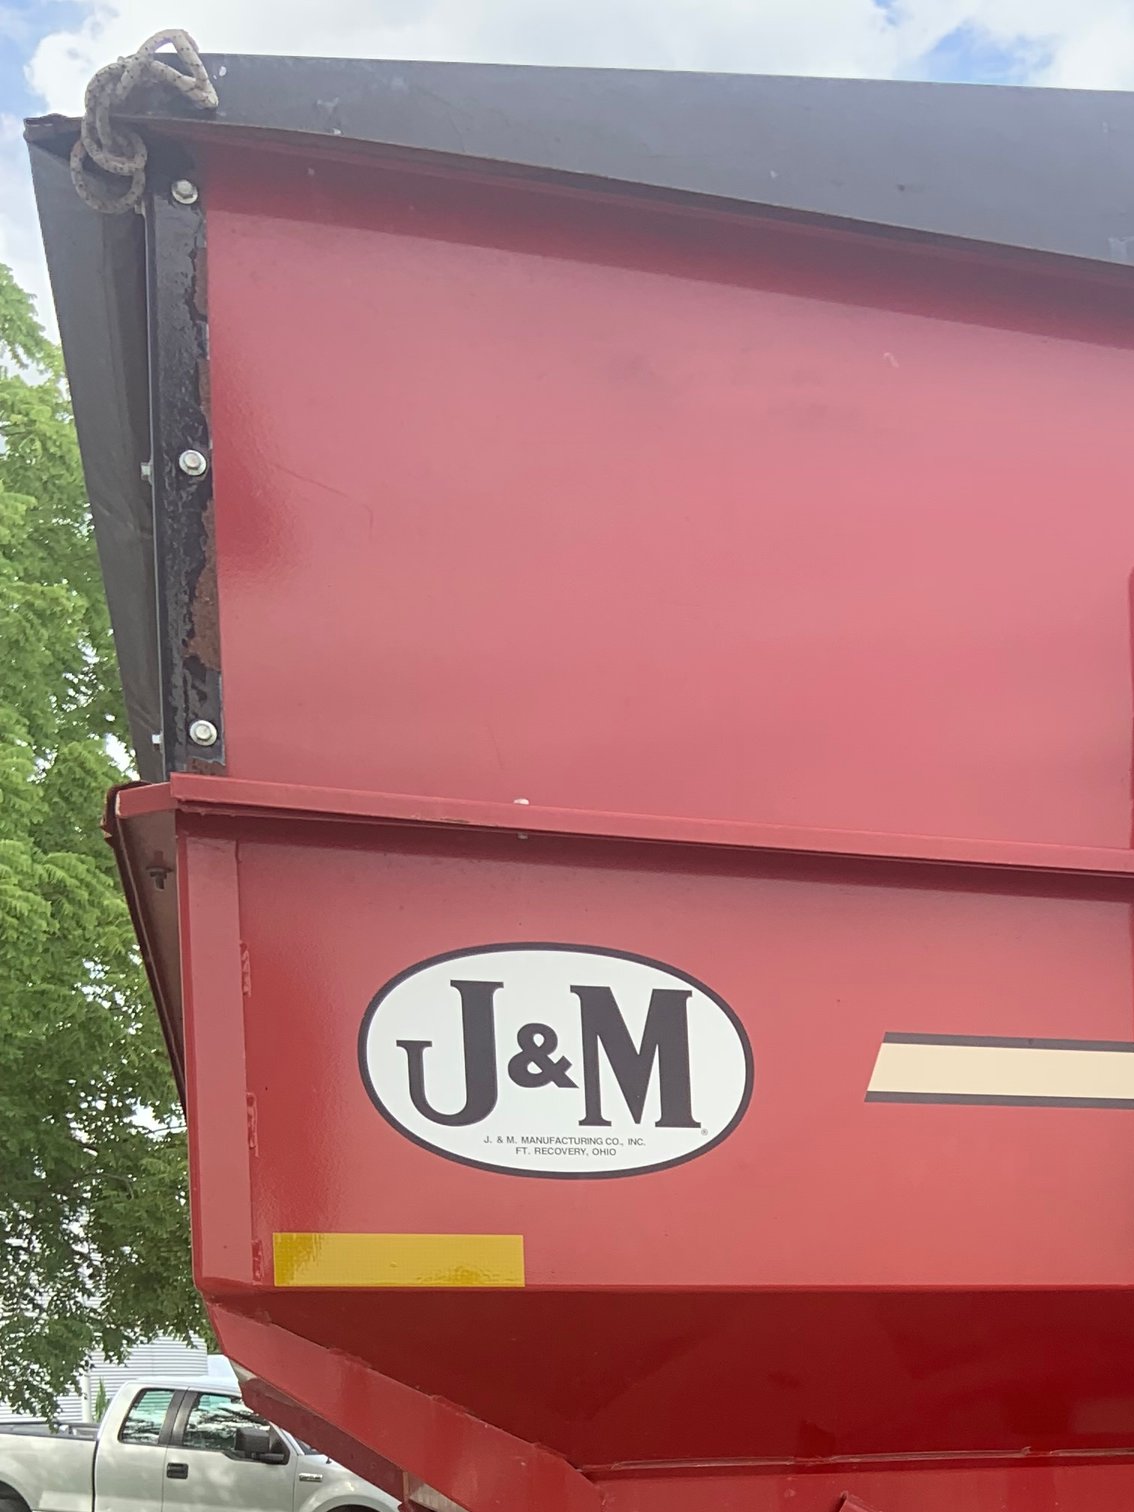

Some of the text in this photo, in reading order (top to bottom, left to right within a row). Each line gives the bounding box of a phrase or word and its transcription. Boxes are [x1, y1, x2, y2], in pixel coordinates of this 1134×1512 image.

[396, 979, 702, 1129] J&M
[483, 1135, 647, 1147] J. & M. MANUFACTURING CO., INC.
[515, 1146, 618, 1157] FT. RECOVERY, OHIO
